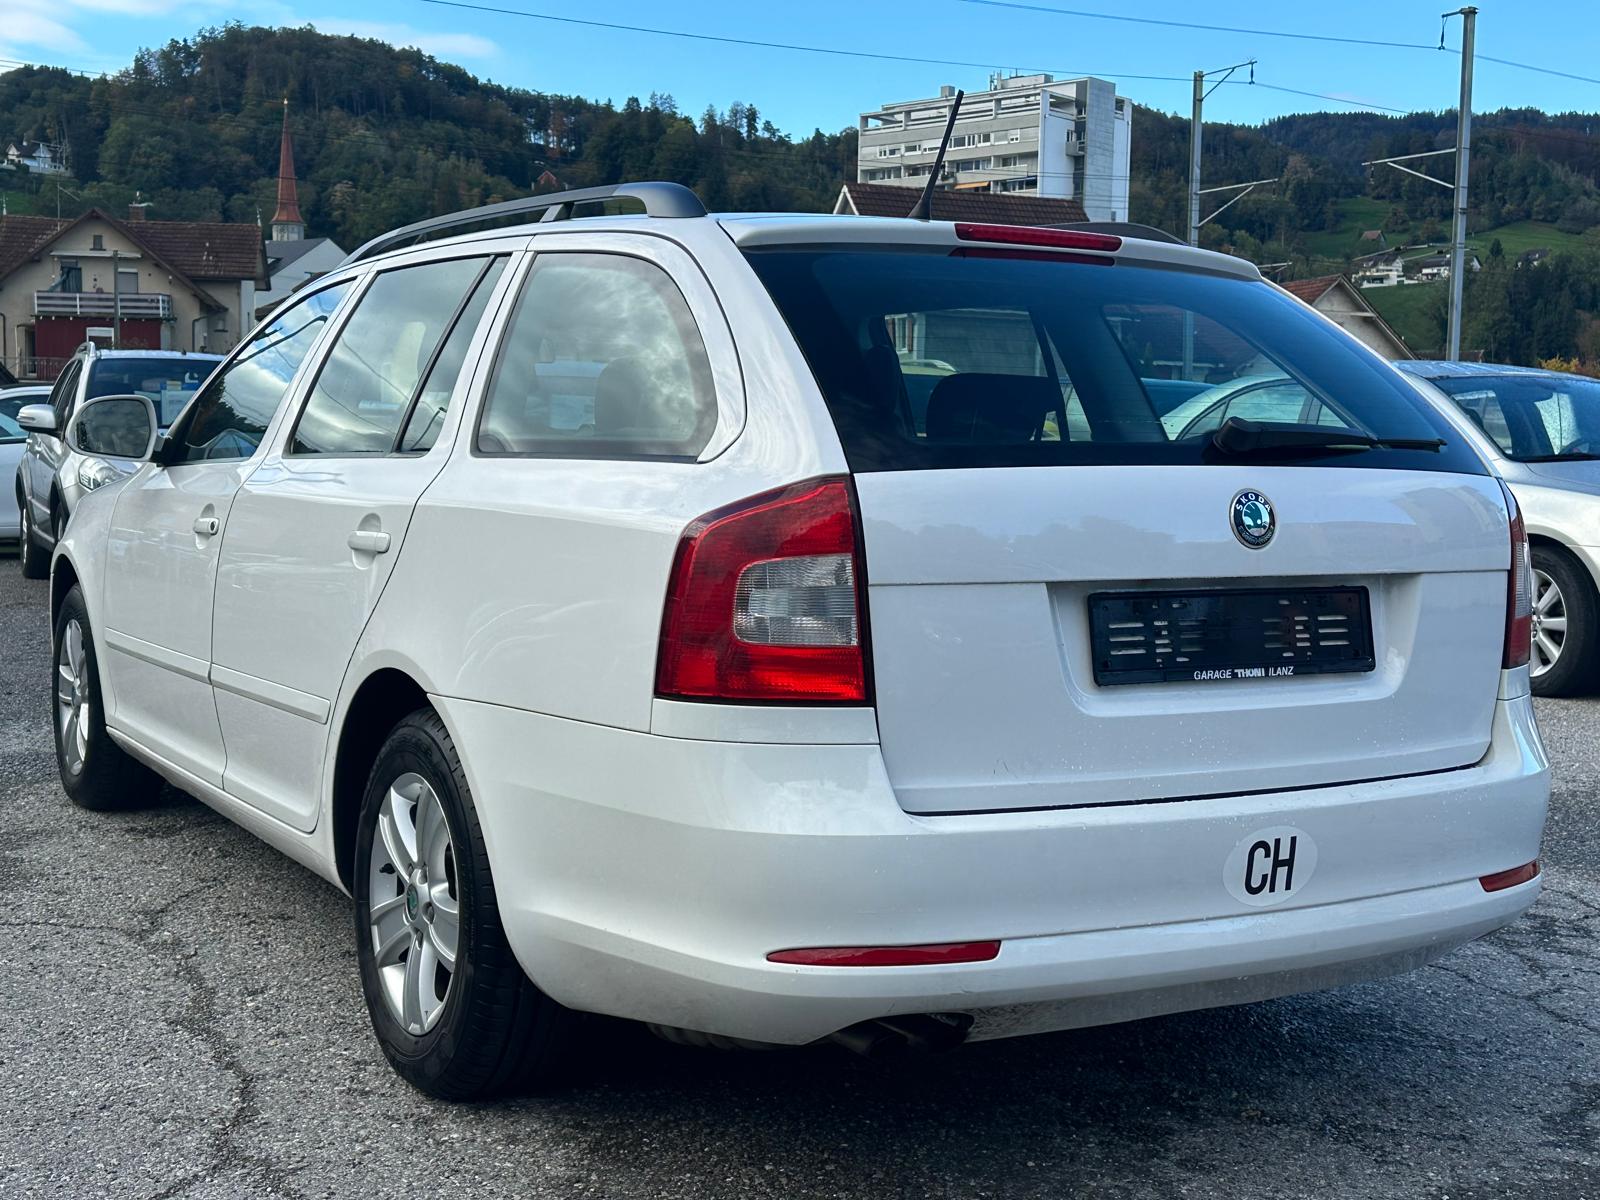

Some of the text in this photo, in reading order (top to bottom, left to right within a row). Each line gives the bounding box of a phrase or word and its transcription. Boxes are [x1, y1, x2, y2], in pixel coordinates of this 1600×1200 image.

[1193, 669, 1232, 680] GARAGE
[1268, 666, 1294, 677] ILANZ
[1244, 835, 1297, 895] CH
